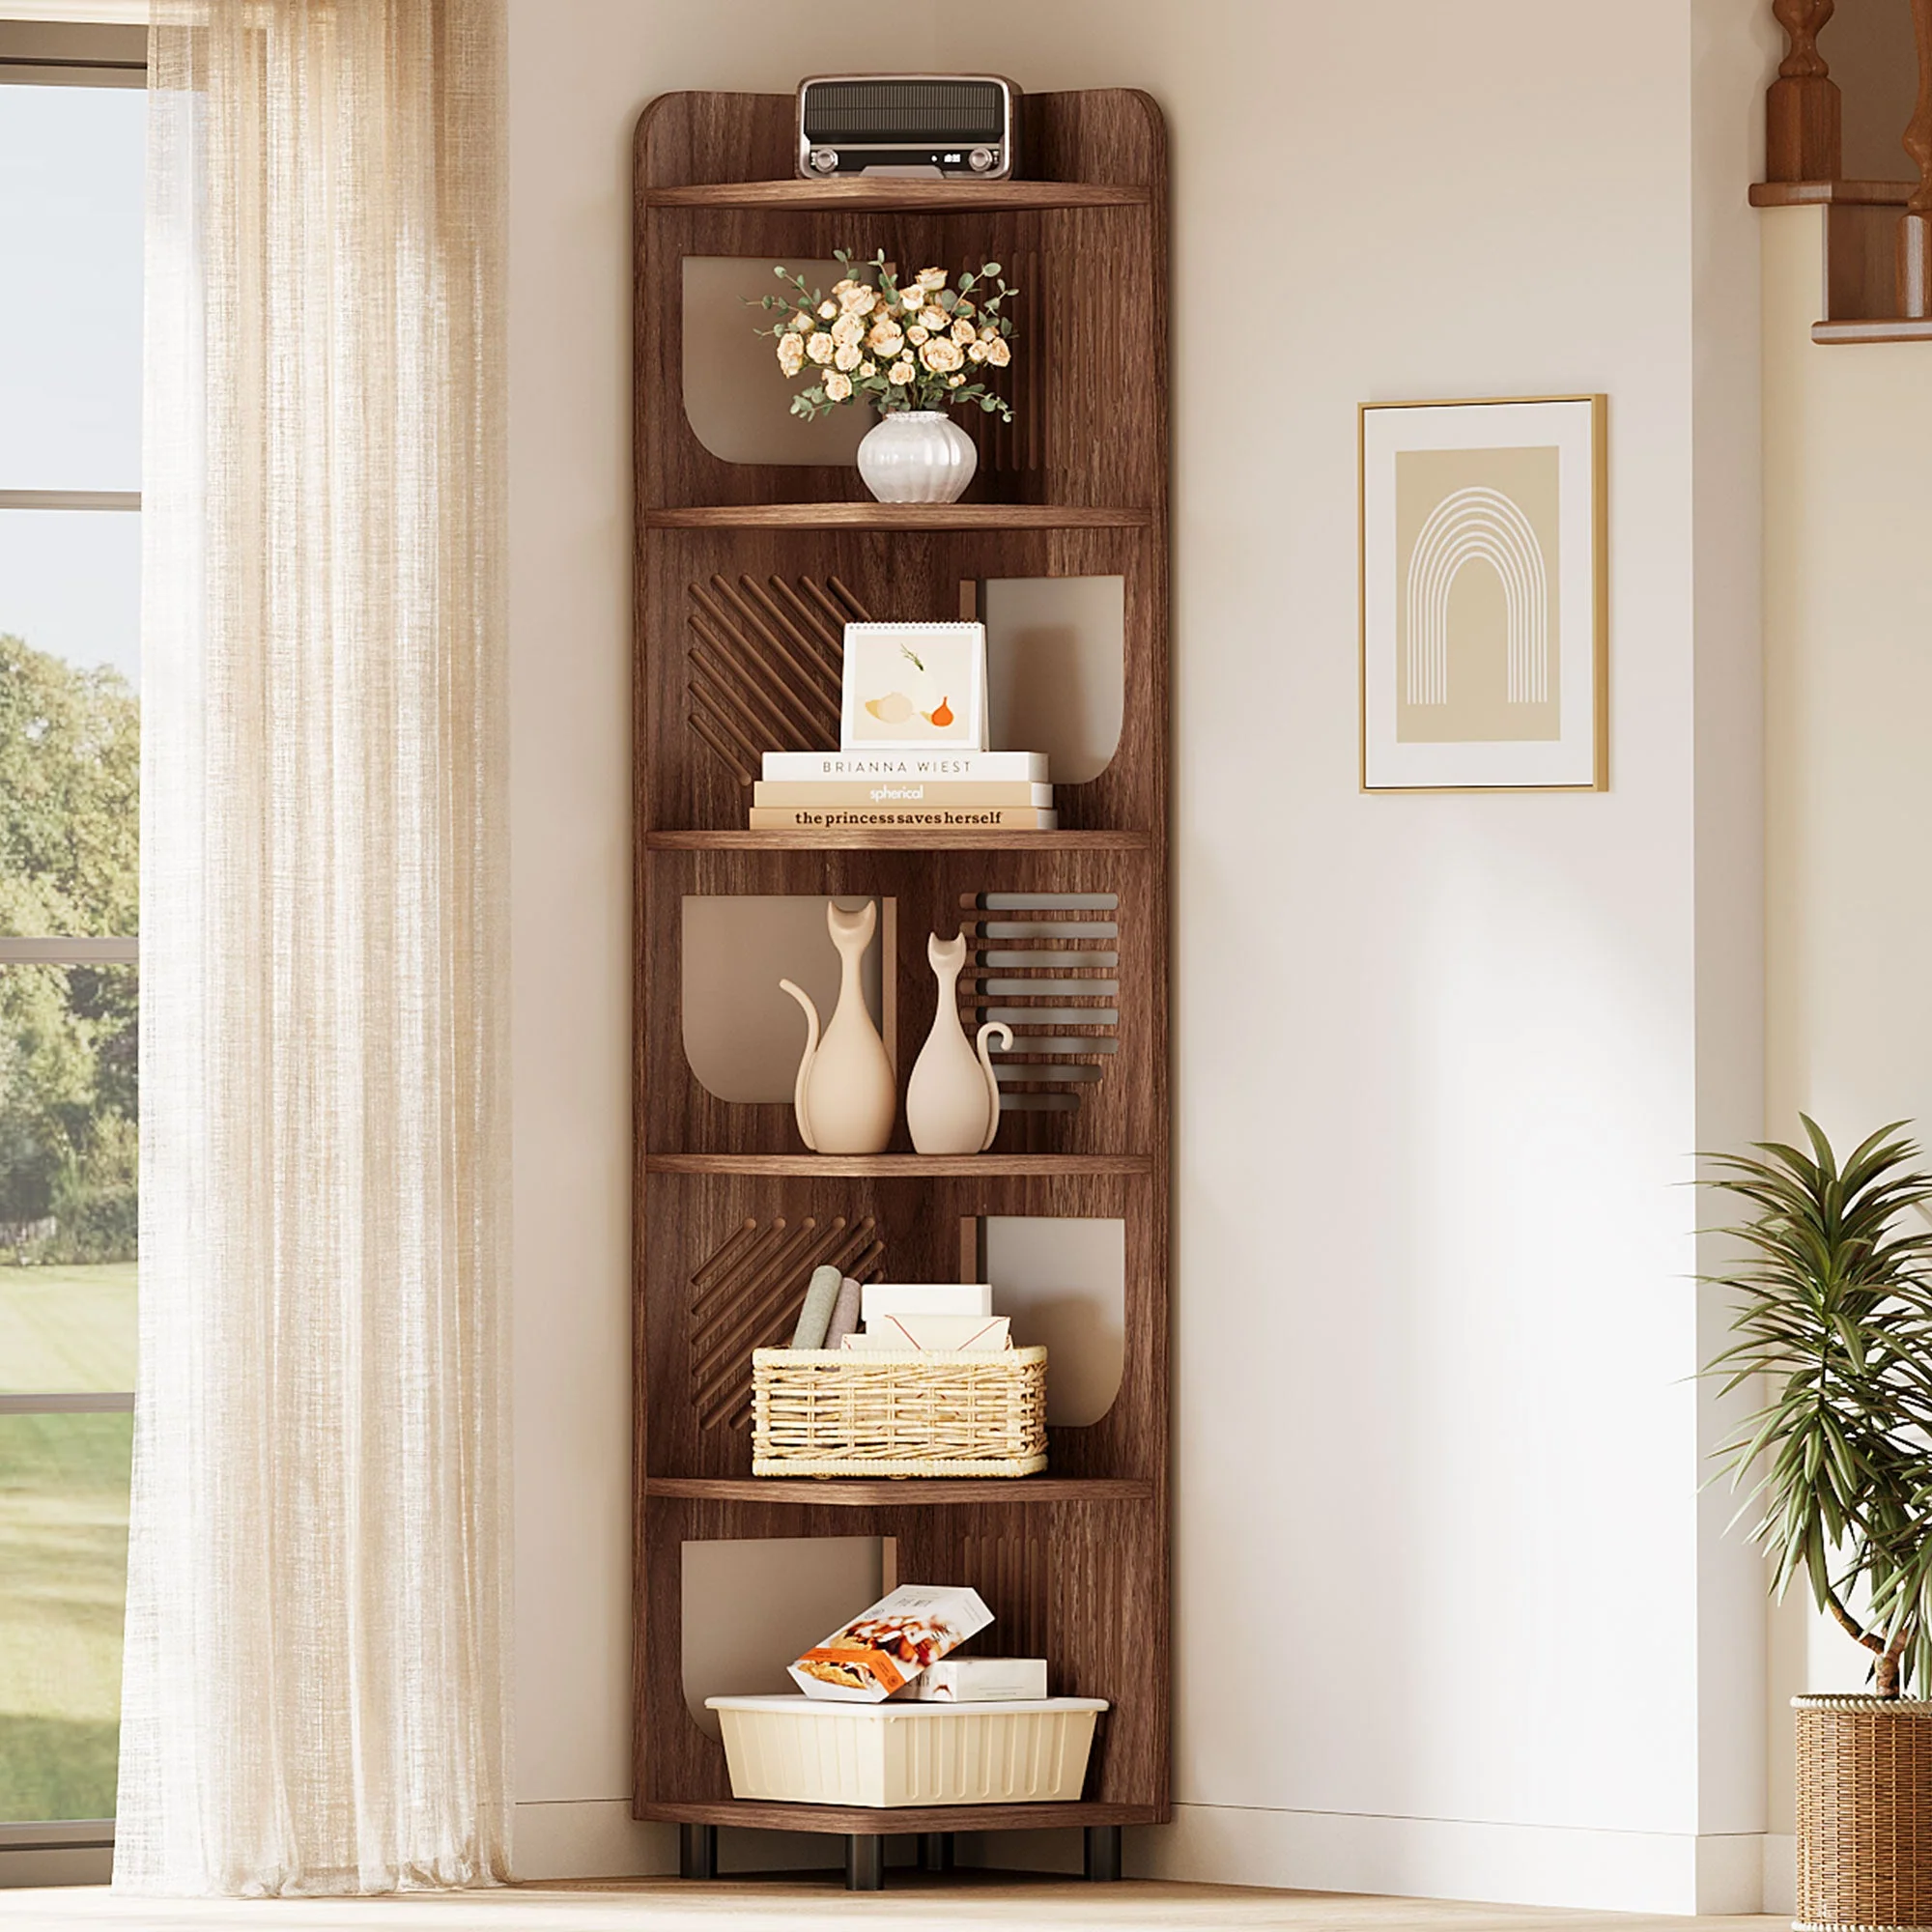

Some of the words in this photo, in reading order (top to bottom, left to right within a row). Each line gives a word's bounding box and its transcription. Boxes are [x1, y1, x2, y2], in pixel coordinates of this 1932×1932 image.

[822, 761, 907, 773] BRIANNA
[917, 761, 971, 773] WIEST
[869, 784, 923, 803] spherical
[795, 811, 822, 824] the
[826, 811, 895, 828] princess
[896, 814, 942, 825] saves
[944, 811, 1002, 824] herself
